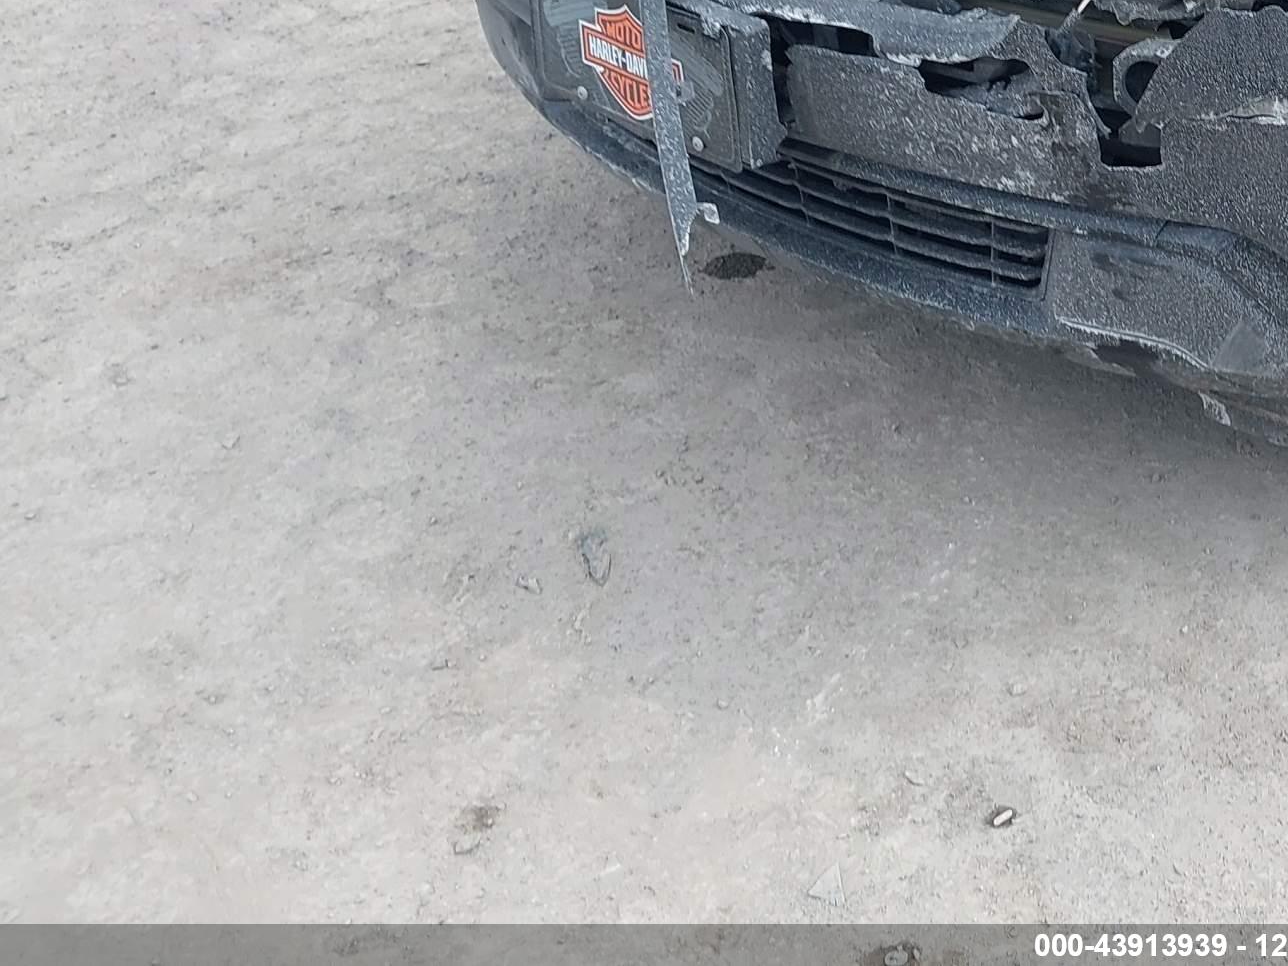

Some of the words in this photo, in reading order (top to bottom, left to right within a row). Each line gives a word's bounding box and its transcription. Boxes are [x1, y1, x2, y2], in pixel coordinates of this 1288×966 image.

[605, 19, 642, 47] MOTO
[588, 34, 648, 79] HARLEY-DAVI
[611, 74, 649, 107] CYCLE
